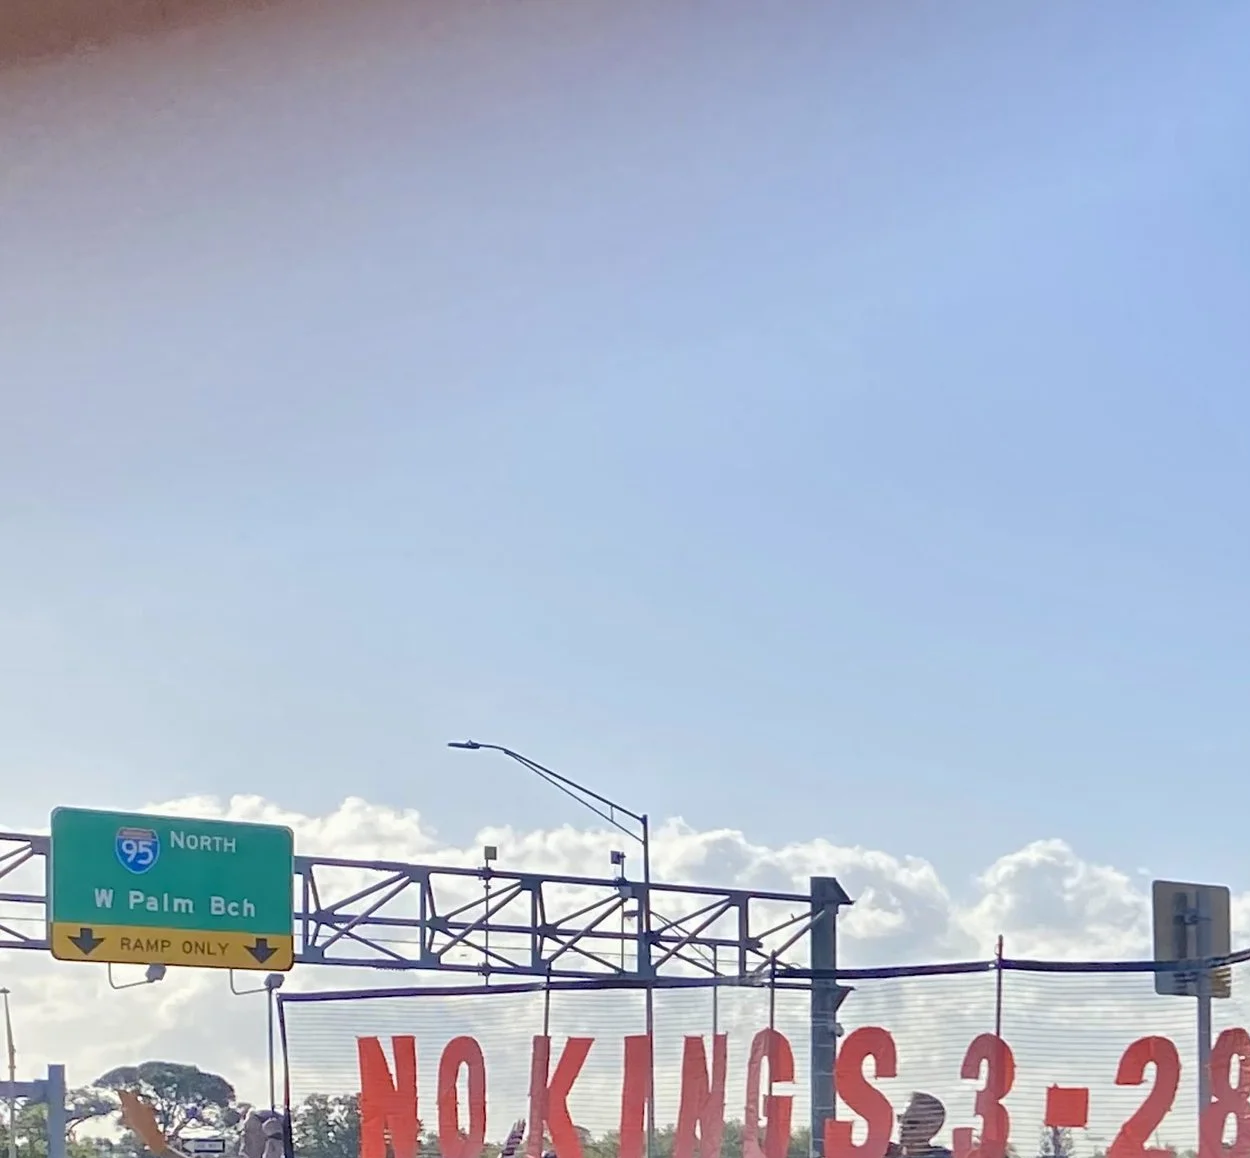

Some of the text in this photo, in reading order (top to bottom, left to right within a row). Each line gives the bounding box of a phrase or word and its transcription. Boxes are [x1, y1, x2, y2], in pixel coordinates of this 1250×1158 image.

[121, 831, 236, 865] 95 NORTH
[94, 888, 256, 918] W Palm Bch
[120, 937, 231, 956] RAMP ONLY
